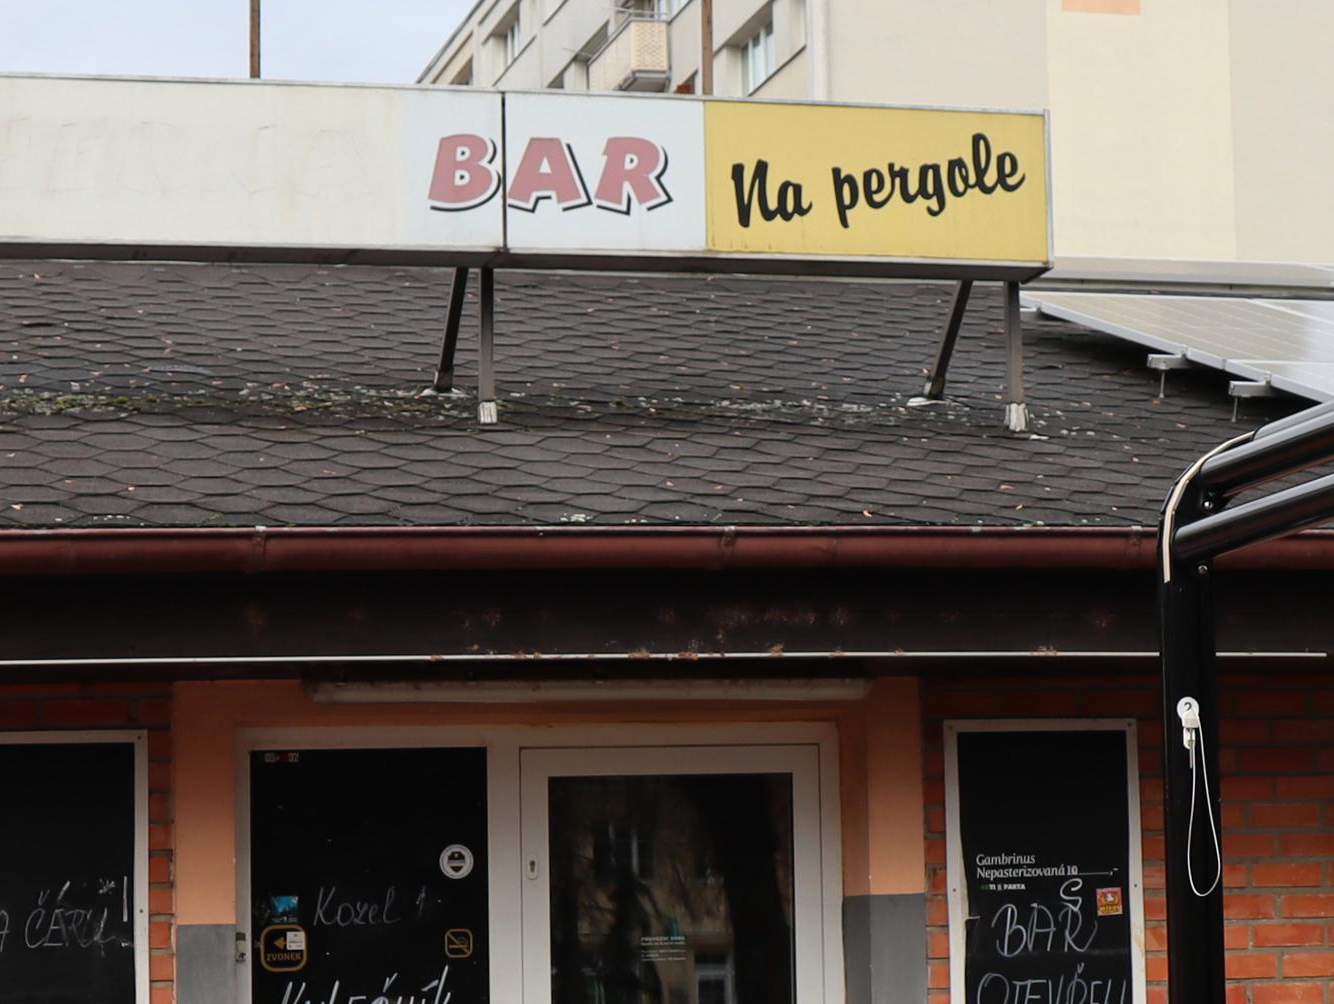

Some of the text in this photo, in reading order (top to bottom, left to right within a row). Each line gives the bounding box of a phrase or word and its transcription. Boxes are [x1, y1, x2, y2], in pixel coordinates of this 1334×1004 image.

[428, 133, 672, 213] BAR
[730, 132, 1027, 228] Na pergole
[976, 853, 1036, 866] Gambrinus
[976, 864, 1065, 881] Nepasterizovaná
[266, 952, 302, 961] ZVONEK
